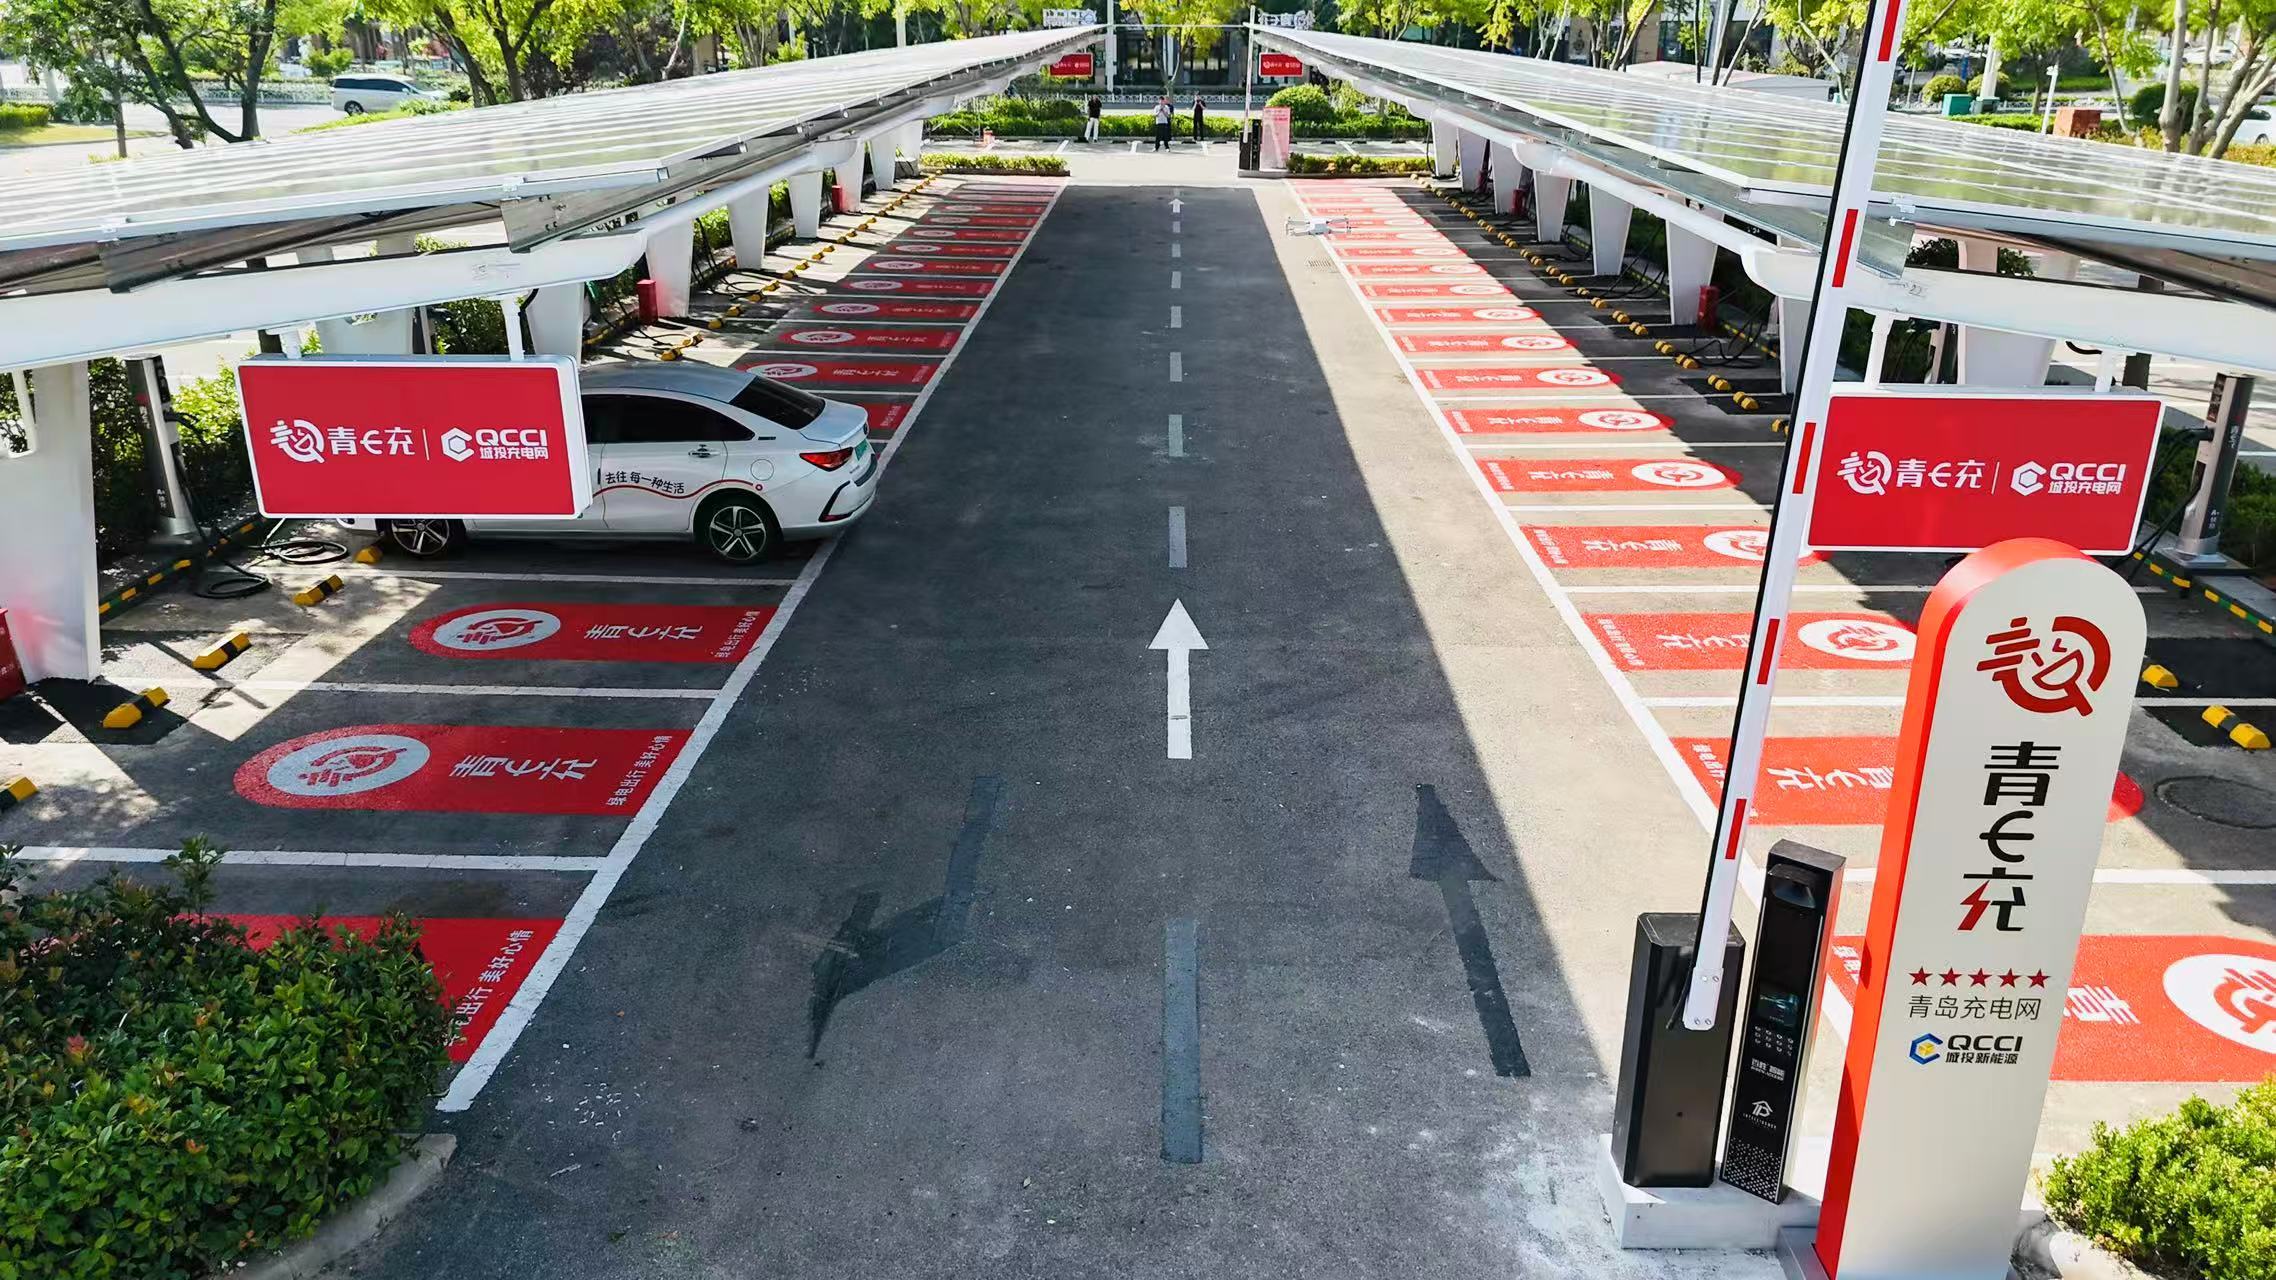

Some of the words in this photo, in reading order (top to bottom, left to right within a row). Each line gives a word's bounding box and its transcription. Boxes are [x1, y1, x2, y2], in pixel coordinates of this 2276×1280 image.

[475, 428, 548, 448] QCCI
[479, 446, 549, 460] 城投充电网
[2049, 462, 2127, 482] QCCI
[630, 471, 685, 495] 每一种生活
[2048, 480, 2123, 495] 城投充电网
[478, 929, 534, 983] 美好心情
[1908, 995, 2041, 1020] 青岛充电网
[1947, 1034, 2023, 1051] QCCI
[1945, 1052, 2020, 1065] 城投新能源
